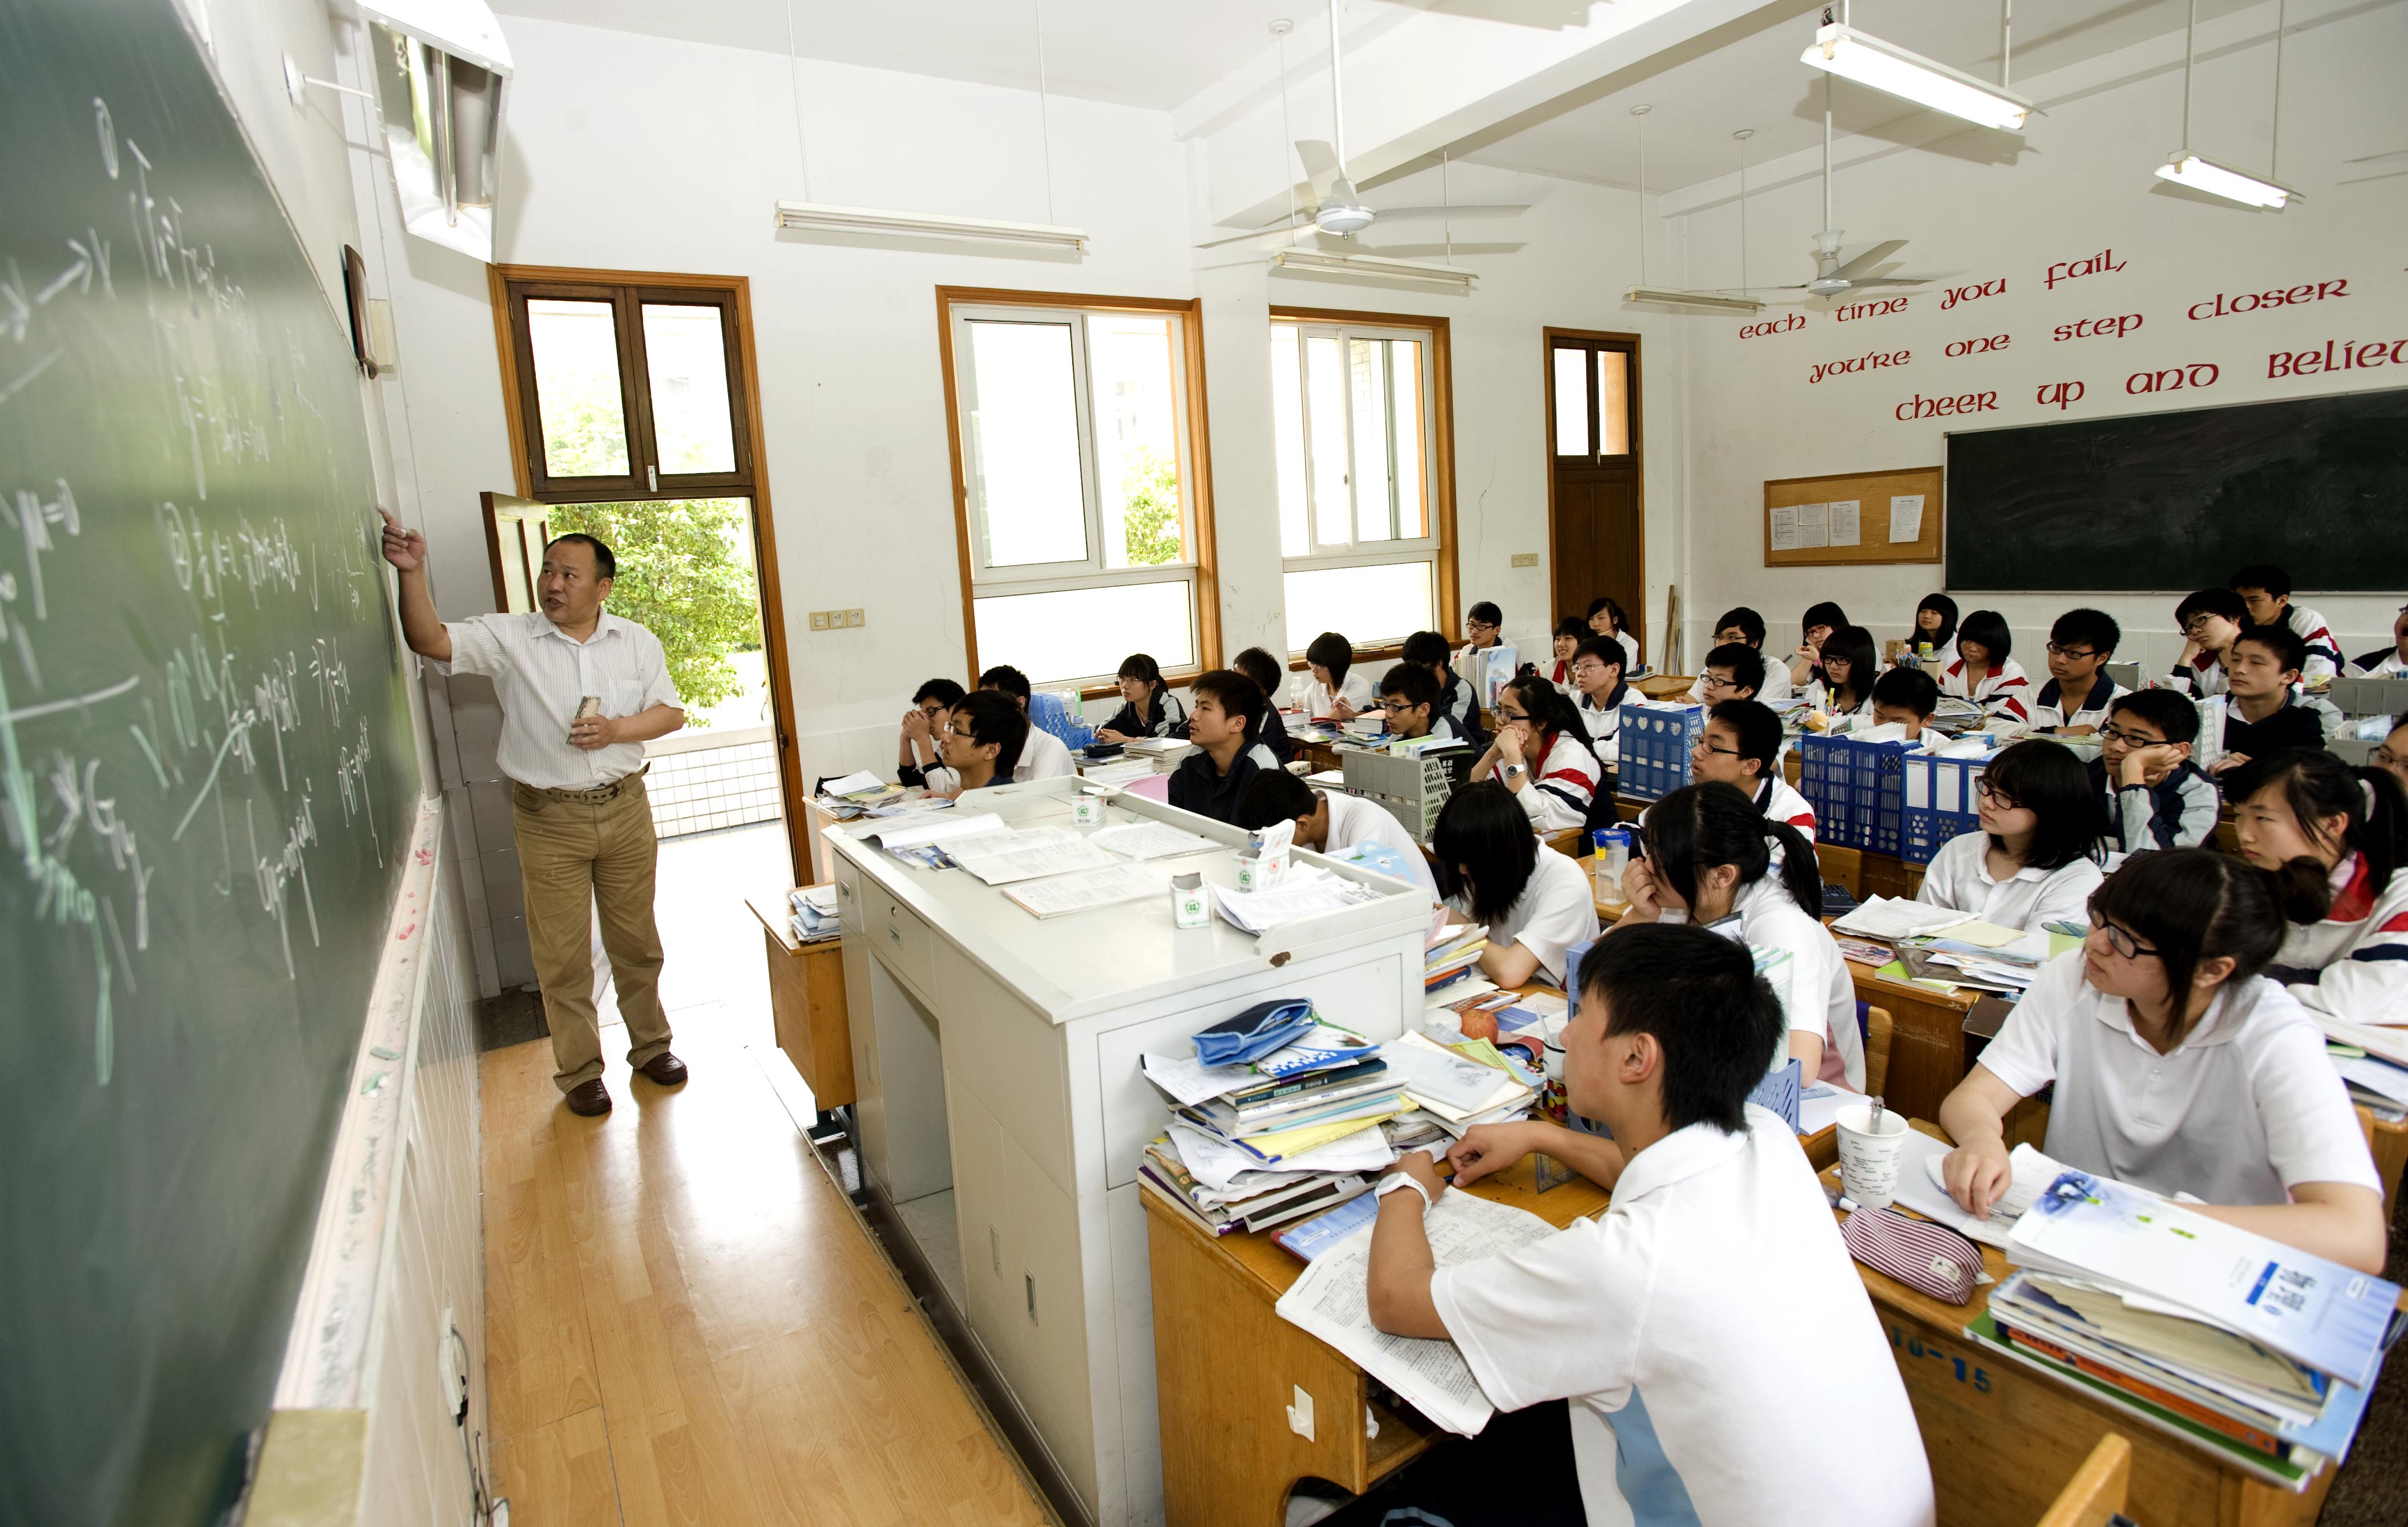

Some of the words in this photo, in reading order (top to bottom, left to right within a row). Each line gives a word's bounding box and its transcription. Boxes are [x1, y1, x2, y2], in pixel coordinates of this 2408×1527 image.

[1739, 313, 1806, 340] each
[1835, 298, 1909, 323] time
[1940, 278, 2006, 311] you
[2044, 249, 2127, 290] fail,
[1809, 350, 1912, 384] you're
[1945, 334, 2011, 357] one
[2053, 314, 2144, 342] step
[2187, 279, 2351, 321] closer
[1895, 390, 1999, 421] cheer
[2036, 381, 2086, 411] up
[2125, 363, 2219, 395] and
